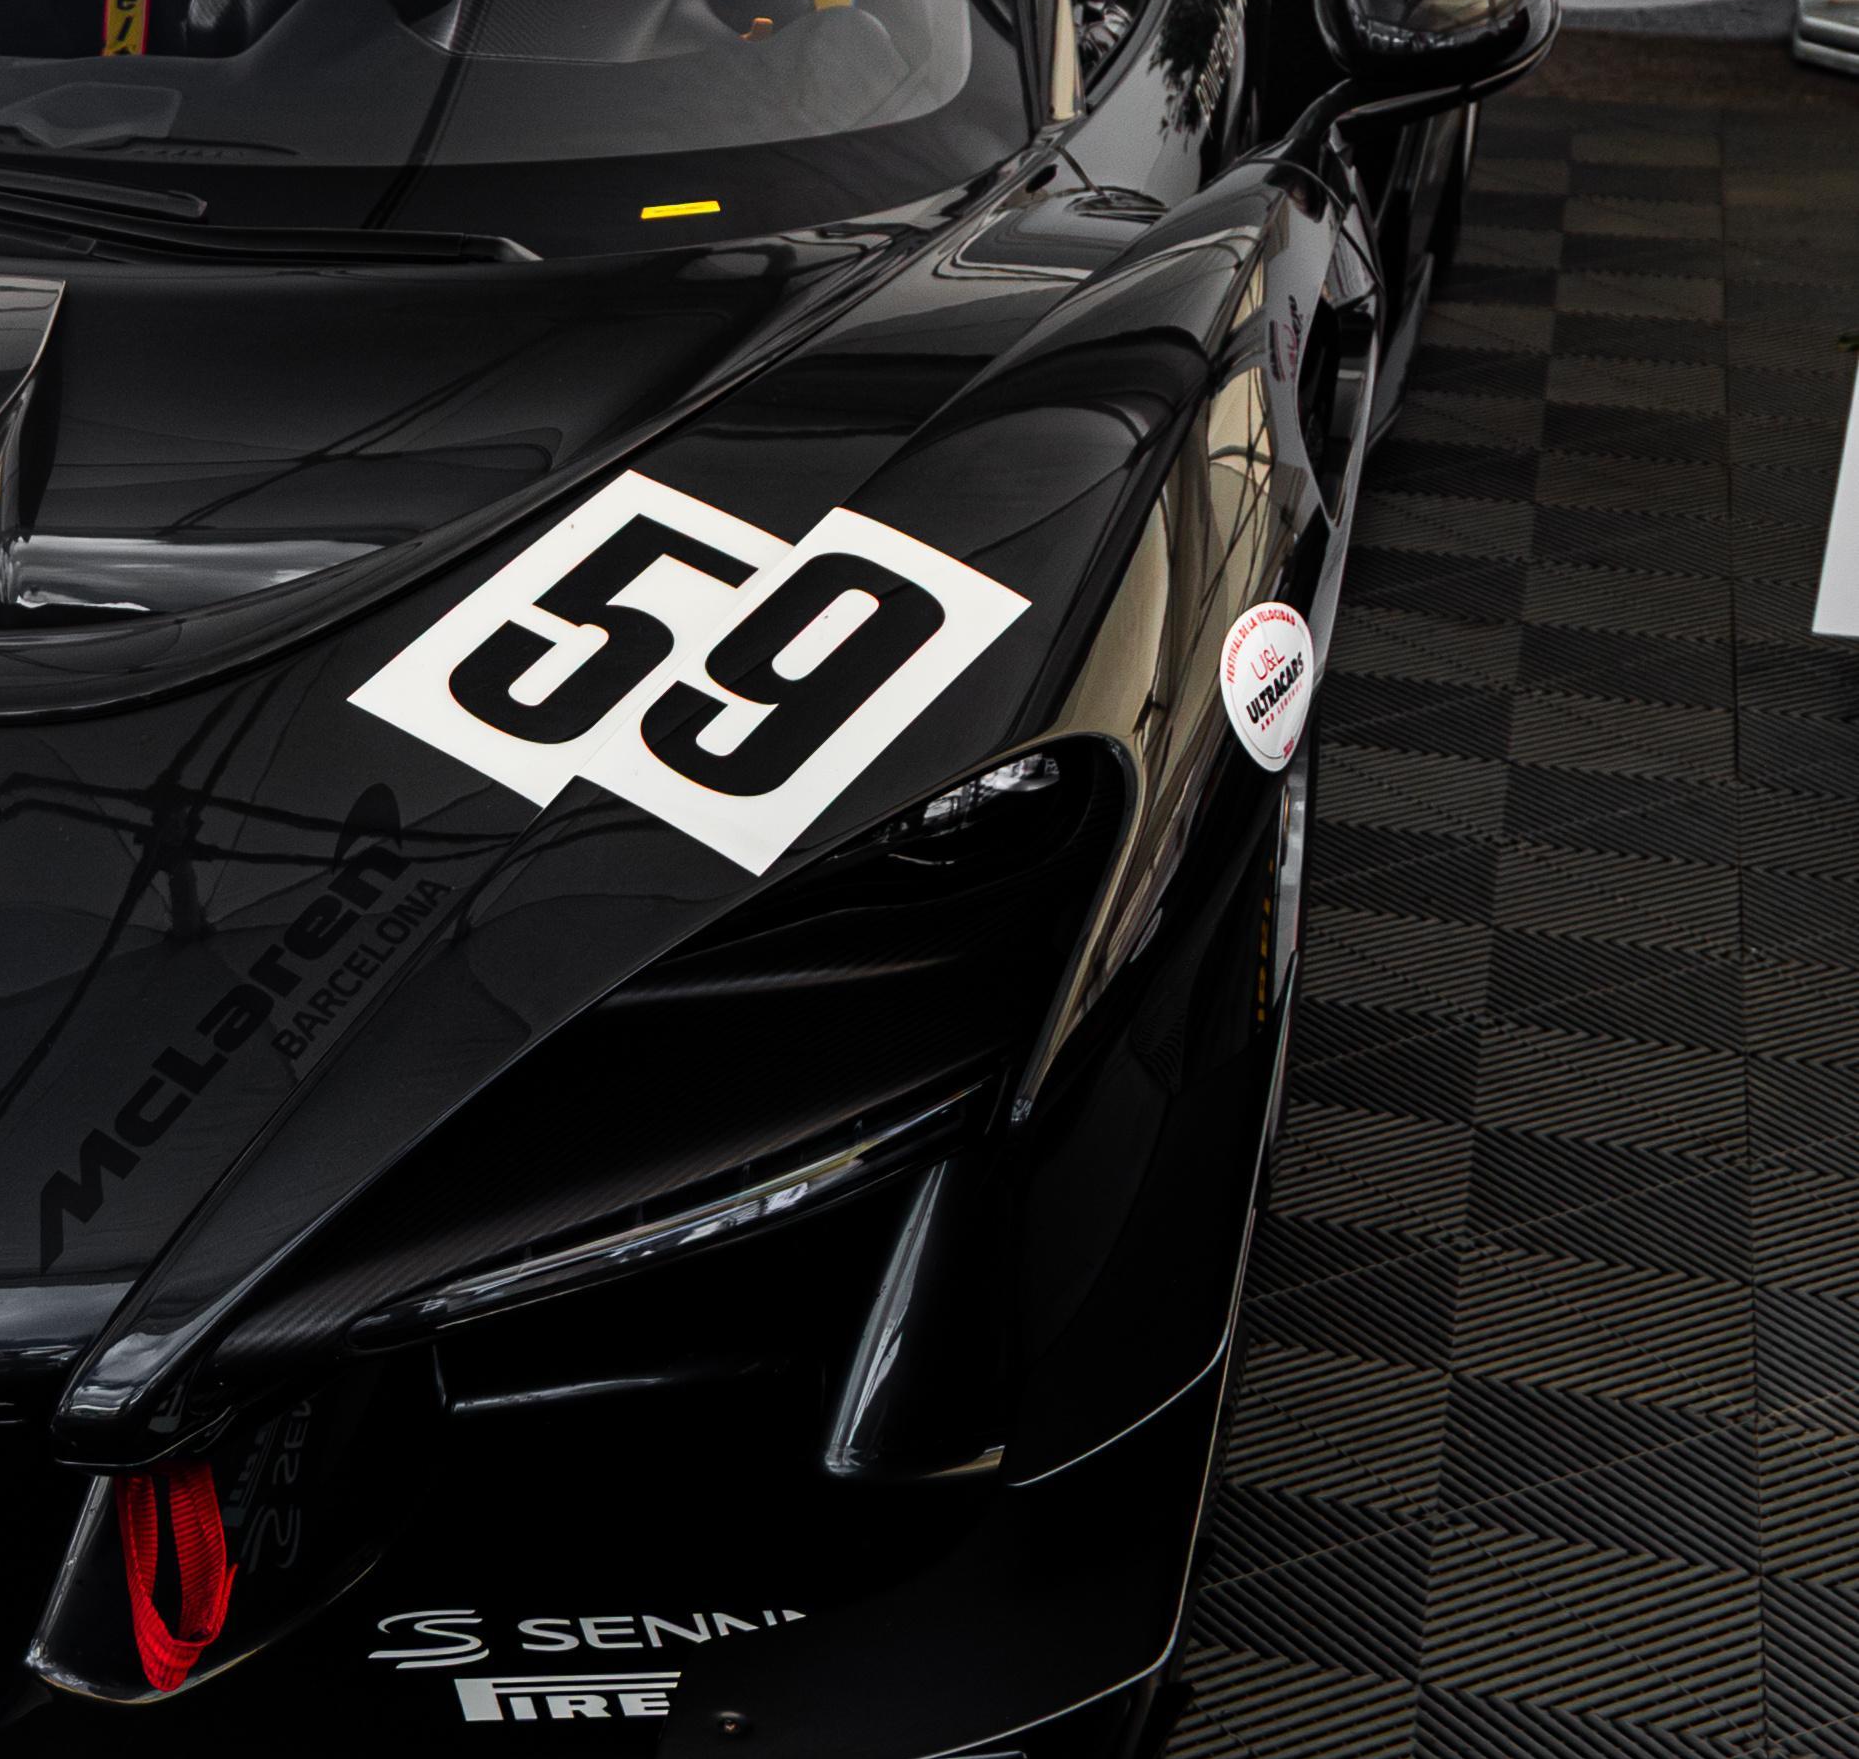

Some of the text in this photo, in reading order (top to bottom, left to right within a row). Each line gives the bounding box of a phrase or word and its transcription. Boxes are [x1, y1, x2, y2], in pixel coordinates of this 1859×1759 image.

[448, 512, 948, 798] 59
[1226, 637, 1243, 684] FESTIVAL
[1246, 651, 1304, 724] ULTRACARS
[272, 877, 453, 1062] BARCELONA
[40, 840, 413, 1275] McLaren
[454, 1671, 682, 1722] PIRE
